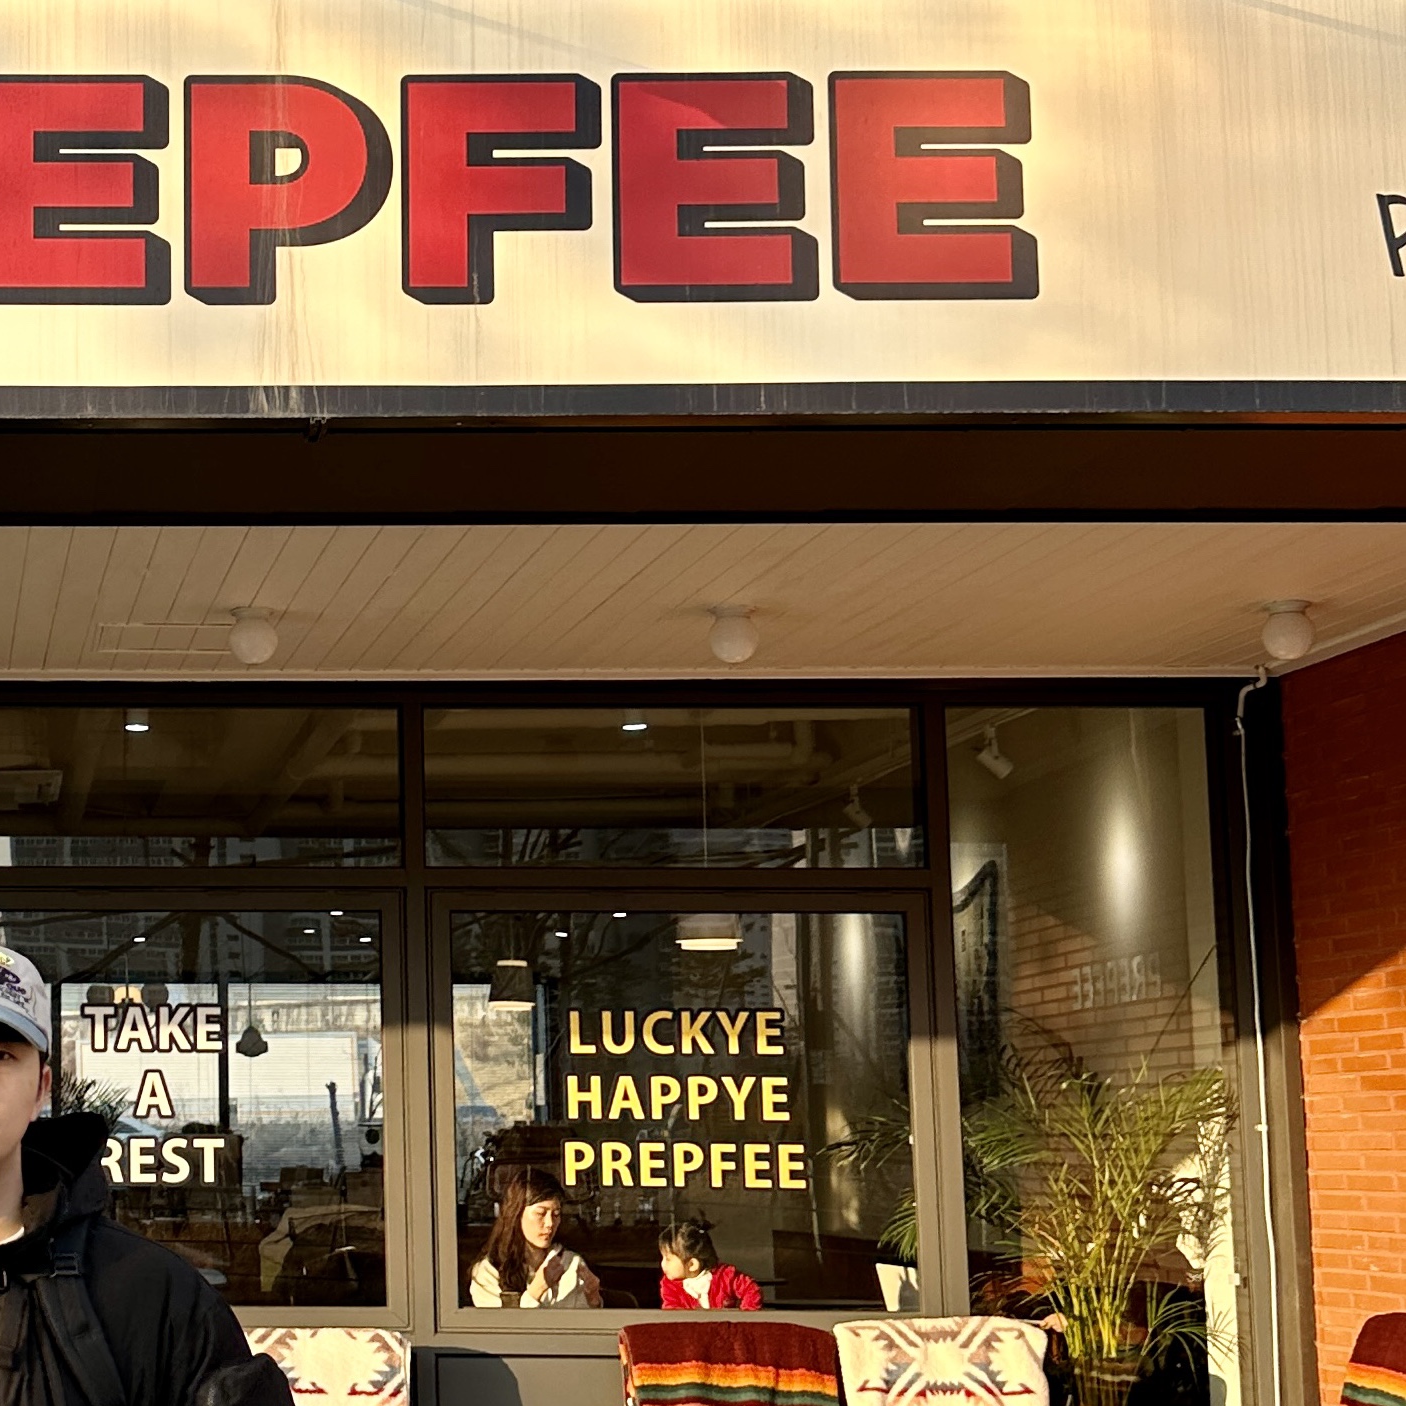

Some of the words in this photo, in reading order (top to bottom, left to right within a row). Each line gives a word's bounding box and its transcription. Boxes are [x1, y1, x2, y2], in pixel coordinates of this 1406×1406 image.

[82, 1005, 223, 1051] TAKE
[569, 1010, 785, 1055] LUCKYE
[134, 1071, 173, 1118] A
[566, 1075, 791, 1121] HAPPYE
[100, 1137, 225, 1184] REST
[564, 1141, 807, 1189] PREPFEE
